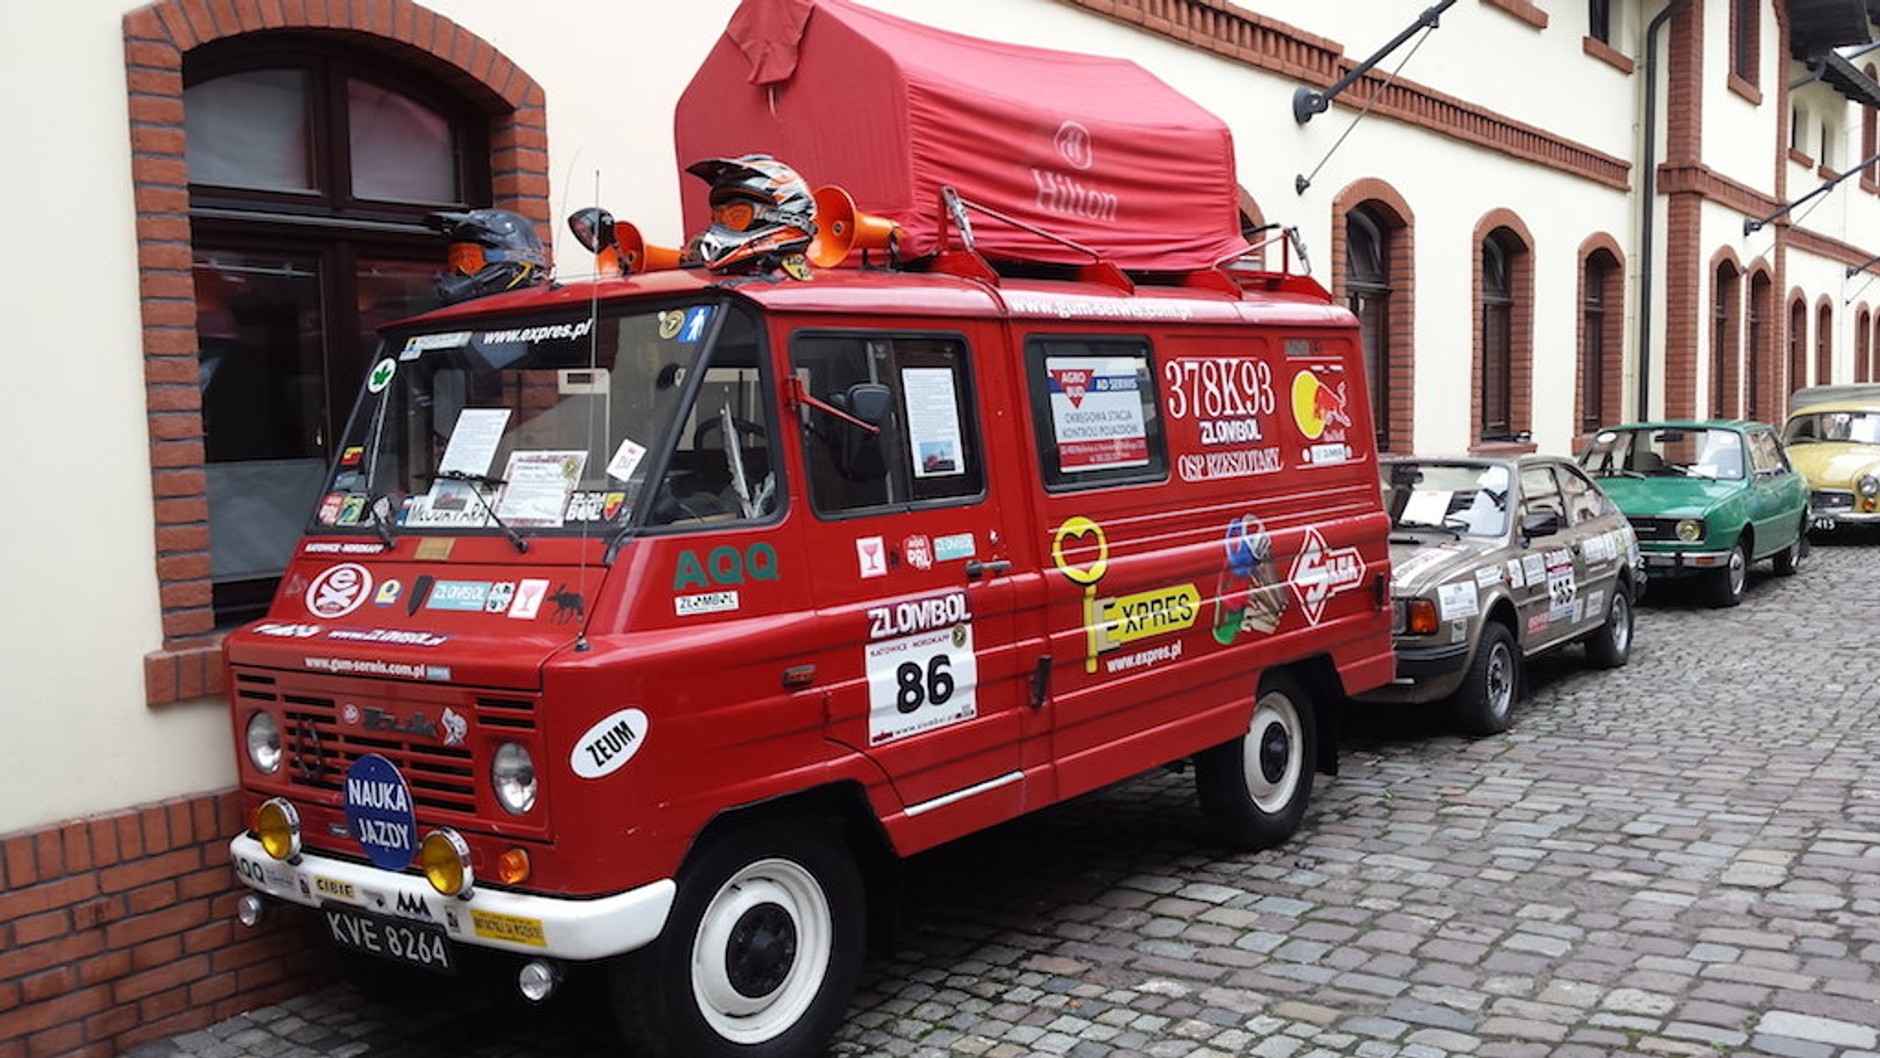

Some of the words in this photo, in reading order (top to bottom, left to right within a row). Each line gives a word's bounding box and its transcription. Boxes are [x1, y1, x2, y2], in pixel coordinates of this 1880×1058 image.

[1030, 168, 1118, 221] Hilton
[483, 319, 593, 345] www.expres.pl
[1061, 371, 1086, 383] AGRO
[1165, 358, 1275, 418] 378K93
[674, 542, 780, 590] AQQ
[1106, 639, 1182, 672] www.expres.pl
[897, 654, 954, 714] 86
[586, 721, 636, 767] ZEUM
[348, 778, 409, 812] NAUKA
[358, 818, 411, 850] JAZDY
[316, 879, 354, 897] CIBIE
[326, 911, 382, 952] KVE
[385, 925, 450, 969] 8264
